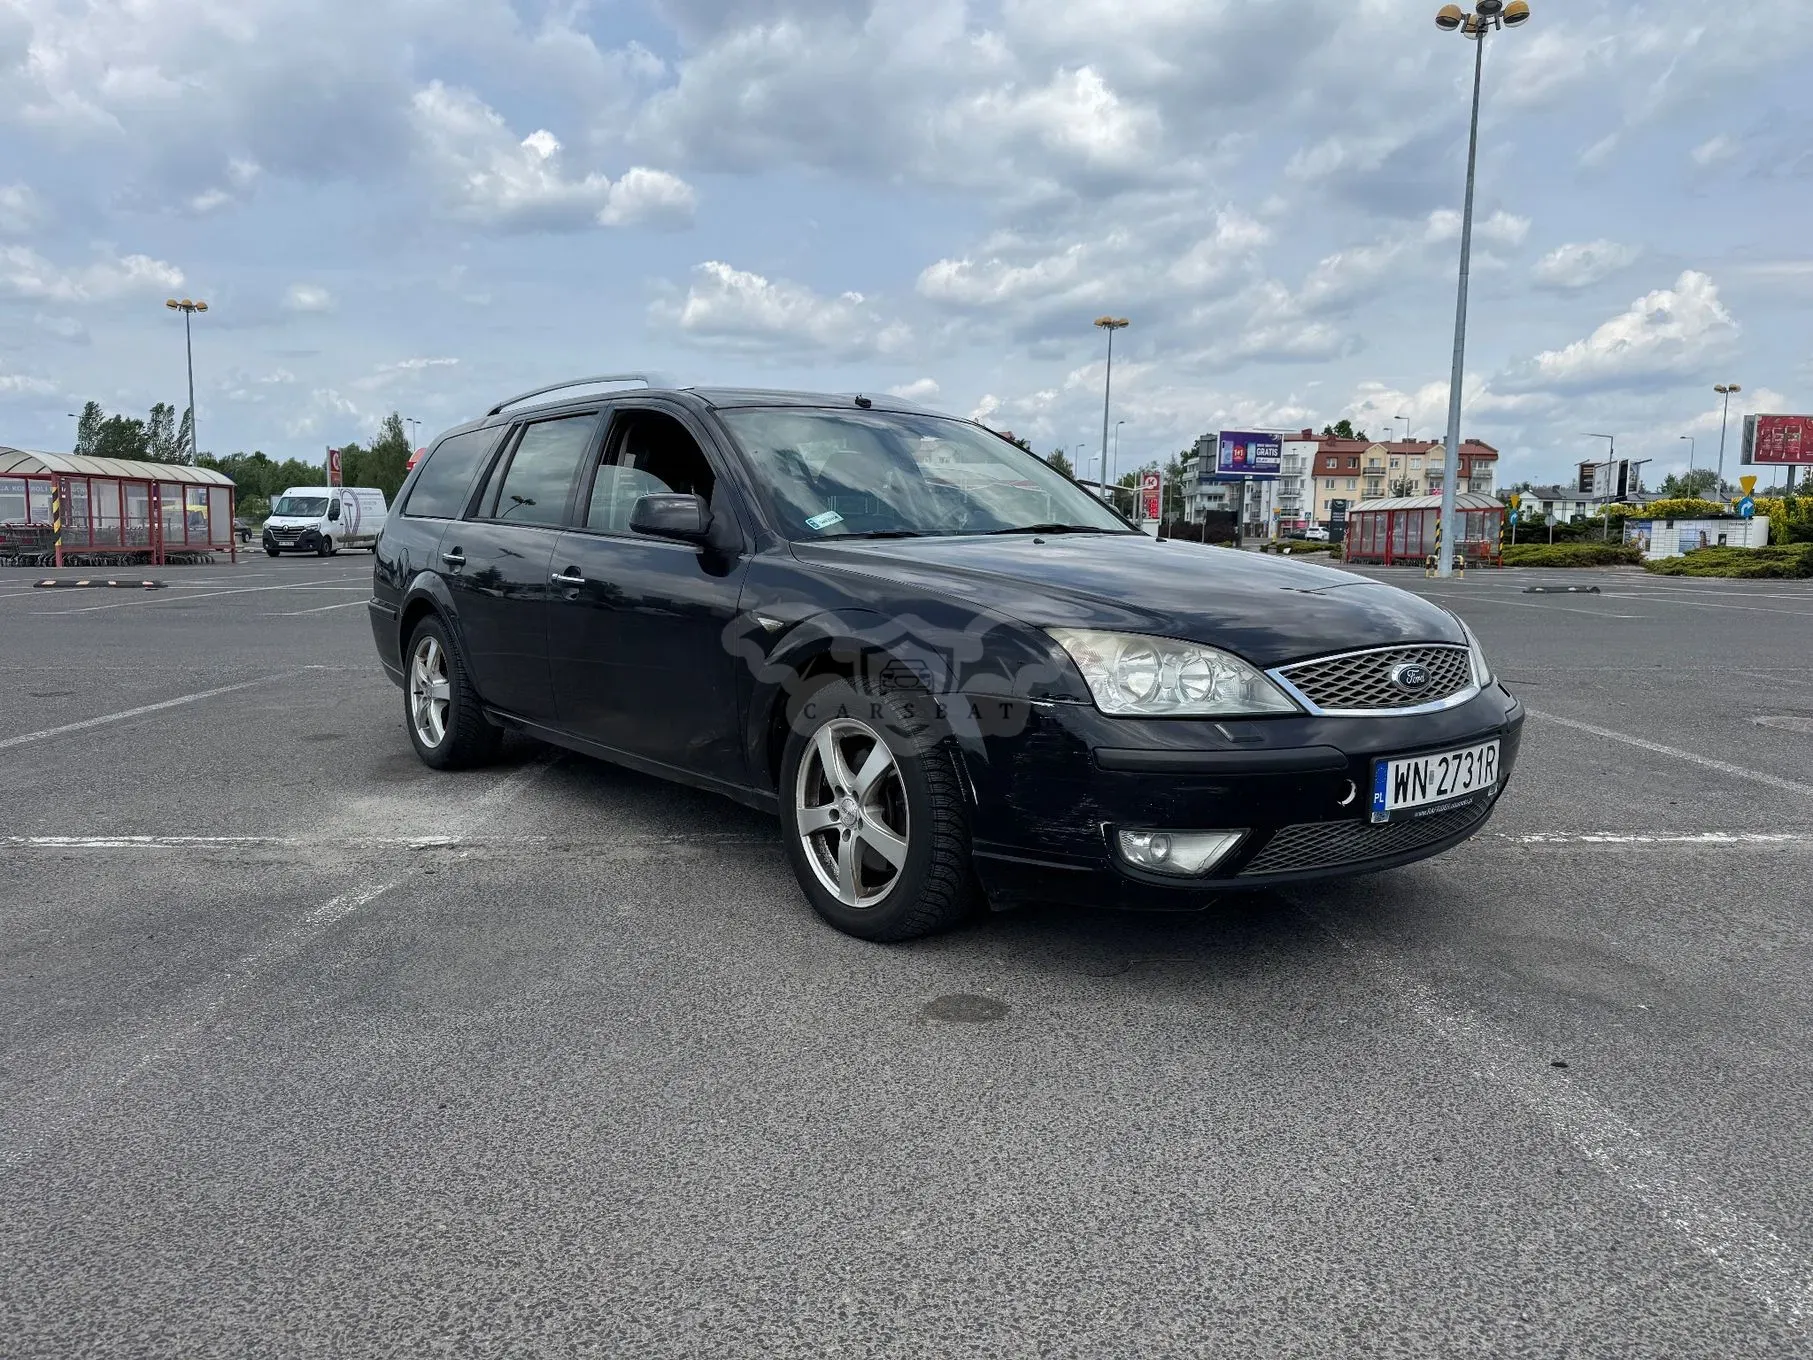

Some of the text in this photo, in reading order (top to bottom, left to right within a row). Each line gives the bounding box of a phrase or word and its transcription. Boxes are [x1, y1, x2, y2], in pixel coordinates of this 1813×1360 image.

[1256, 447, 1279, 457] GRATIS
[1406, 669, 1425, 684] Ford
[1393, 745, 1496, 804] WN 2731R
[1373, 792, 1385, 804] PL
